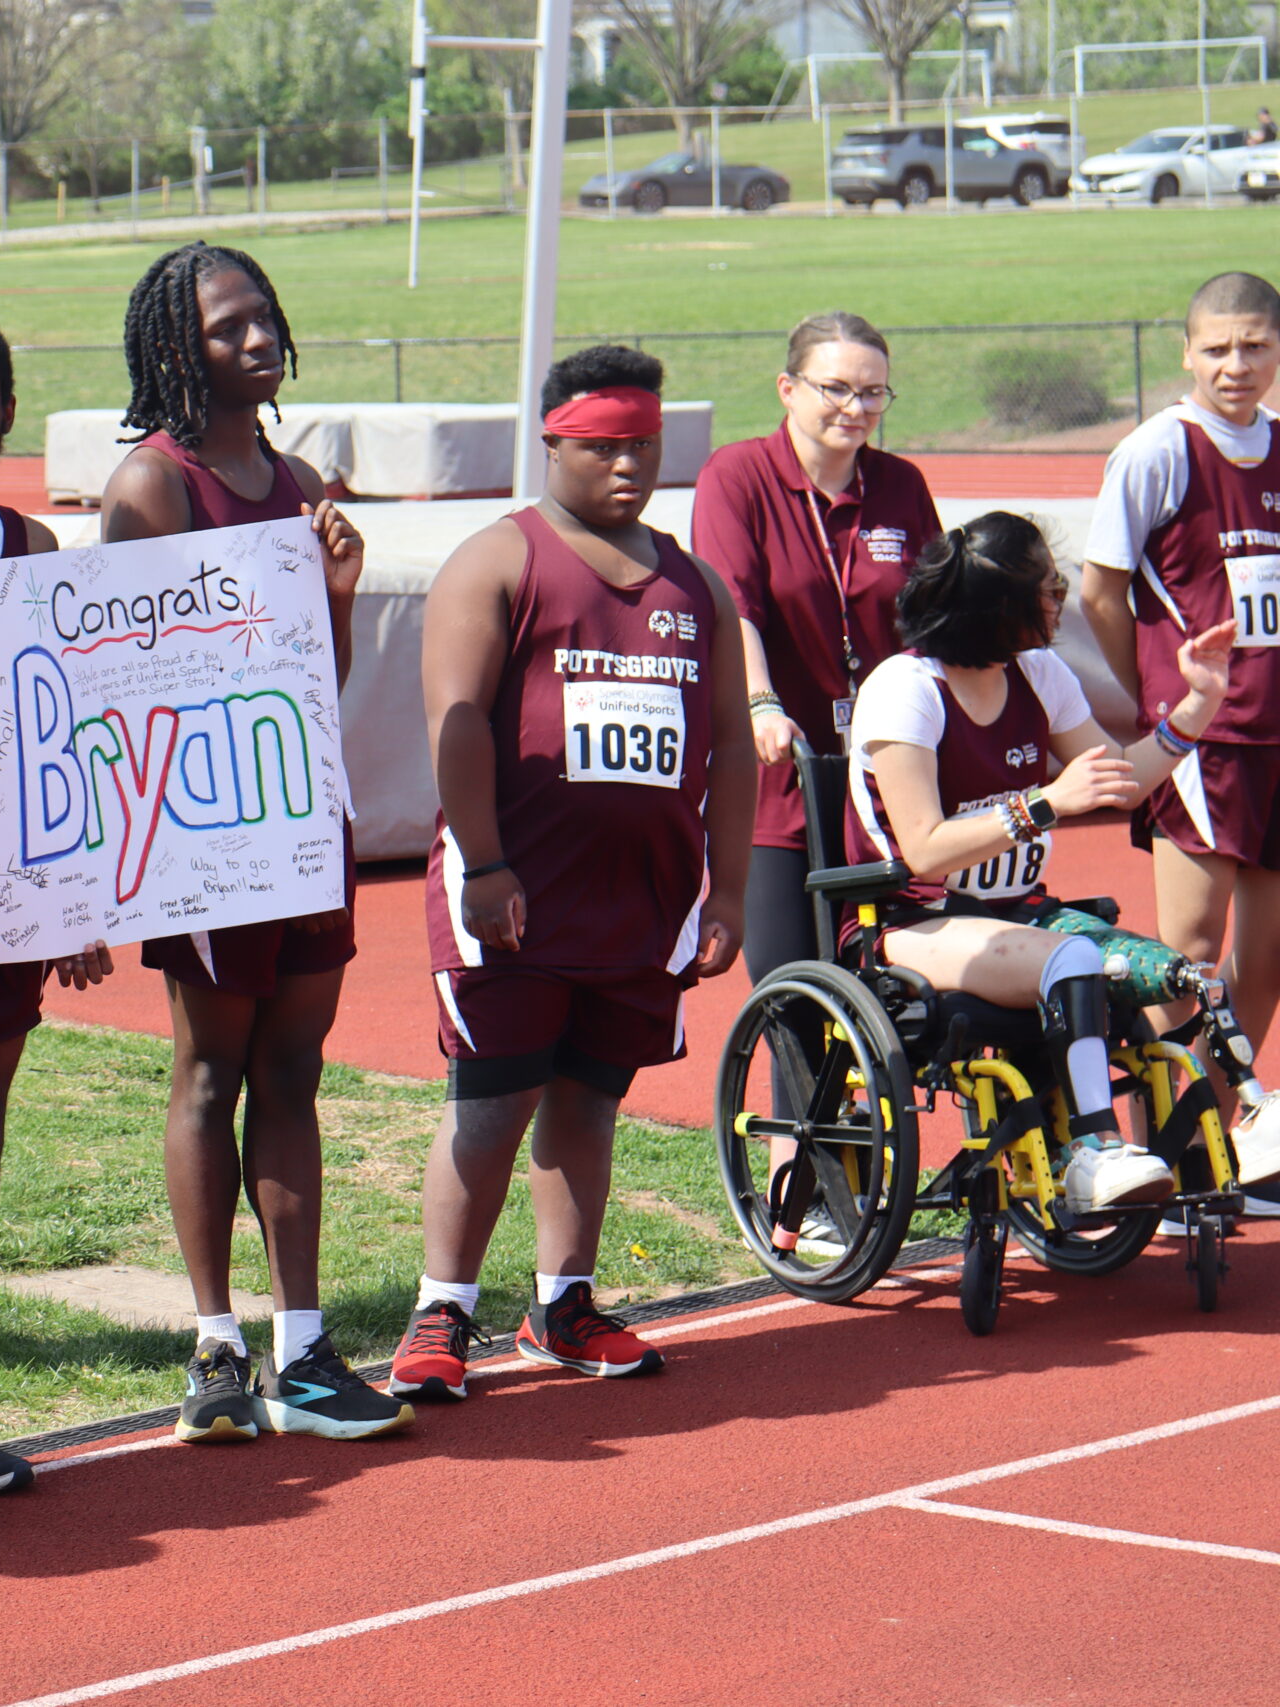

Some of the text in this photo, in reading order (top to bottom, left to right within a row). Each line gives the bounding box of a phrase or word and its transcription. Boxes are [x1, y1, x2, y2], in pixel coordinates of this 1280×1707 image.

[52, 560, 240, 650] Congrats
[101, 667, 118, 677] are
[121, 661, 135, 672] all
[138, 661, 149, 669] so
[150, 651, 182, 669] Proud
[185, 649, 198, 662] of
[136, 668, 176, 684] Unified
[554, 648, 699, 683] POTTSGROVE
[123, 688, 137, 698] are
[138, 685, 147, 695] a
[149, 679, 180, 695] Super
[600, 701, 676, 716] Unified Sports
[573, 723, 679, 776] 1036
[13, 645, 312, 905] Bryan
[190, 856, 219, 881] Way
[226, 858, 240, 870] to
[249, 859, 271, 878] go
